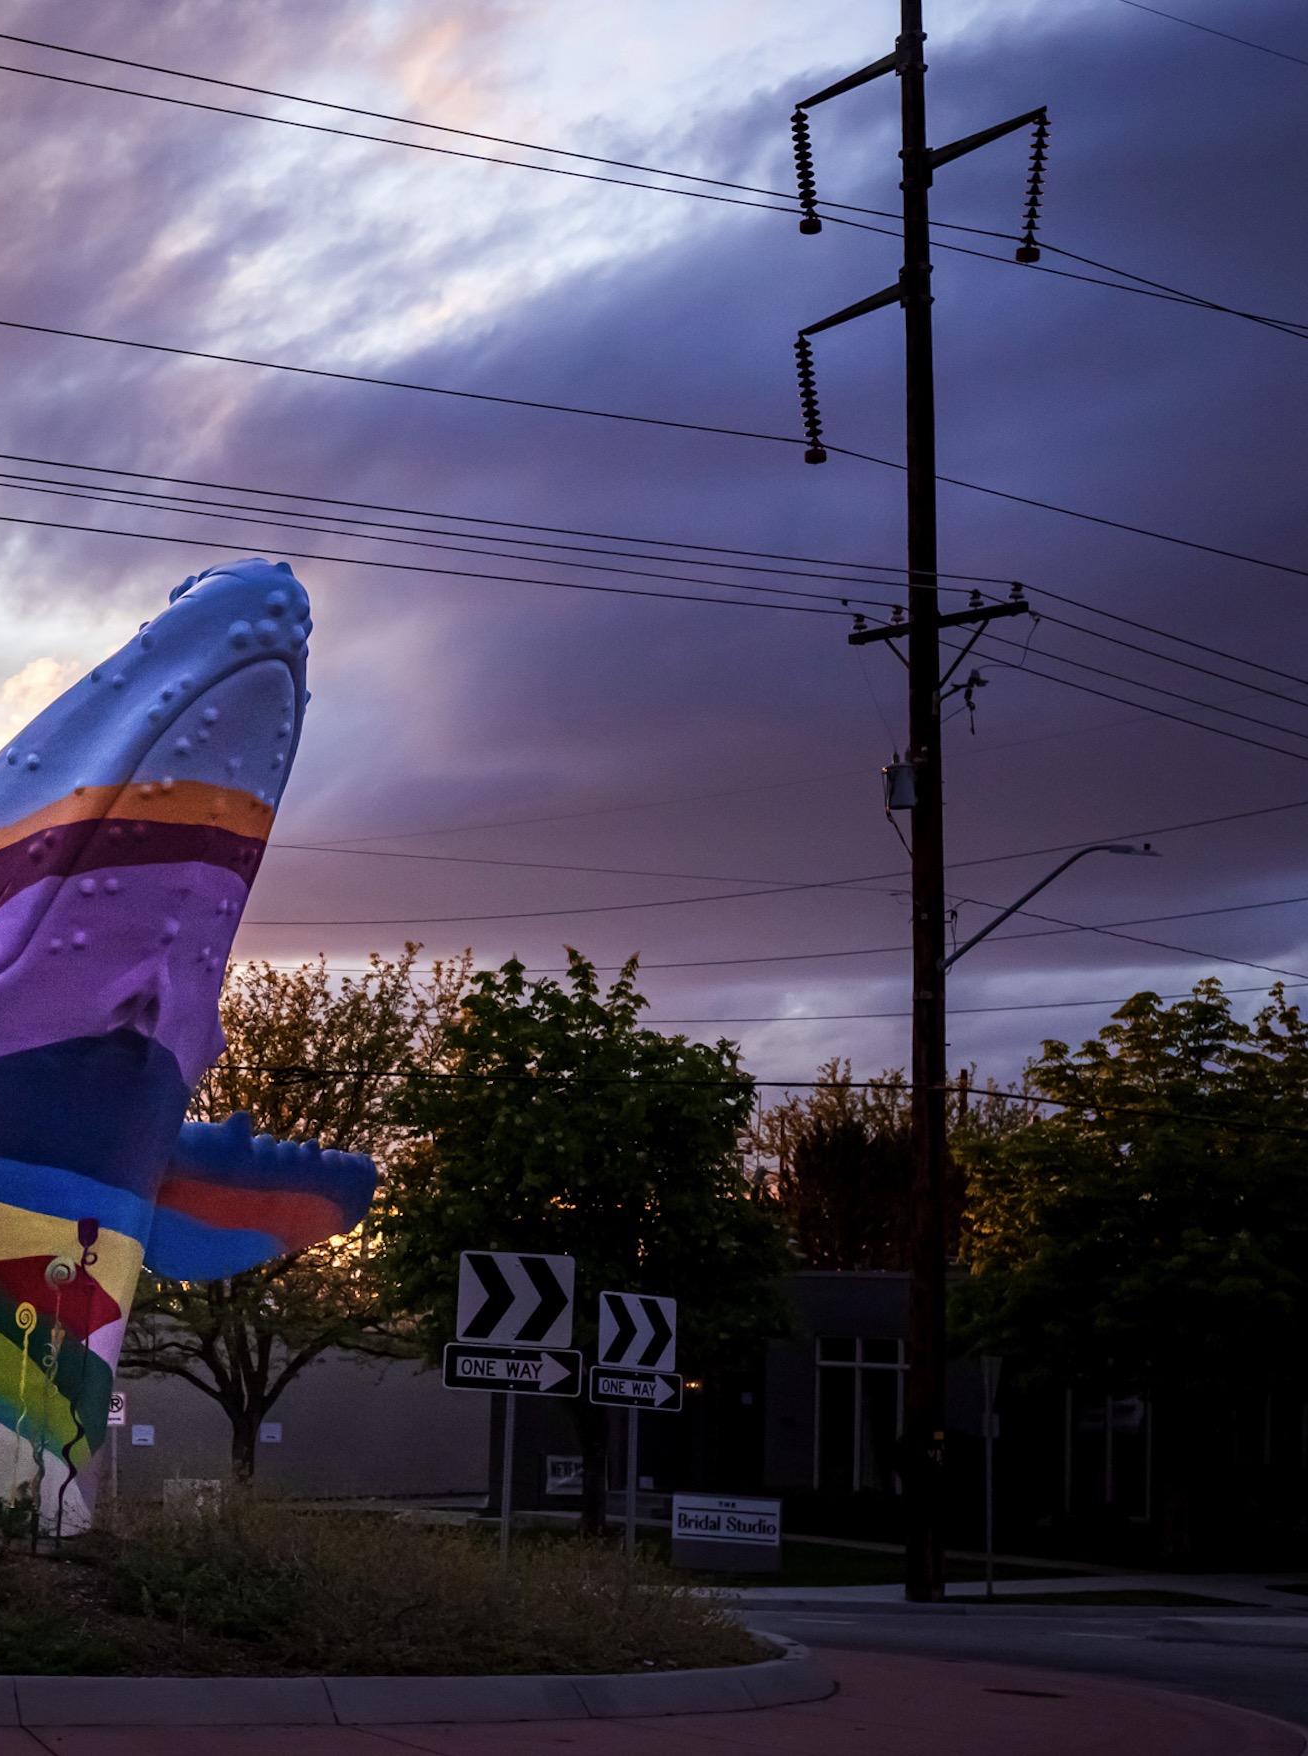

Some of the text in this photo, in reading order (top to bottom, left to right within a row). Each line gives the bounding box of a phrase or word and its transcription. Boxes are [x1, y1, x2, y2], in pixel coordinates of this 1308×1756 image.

[461, 1359, 543, 1379] ONE WAY
[602, 1379, 657, 1397] ONE WAY
[678, 1513, 777, 1535] Bridal Studio
